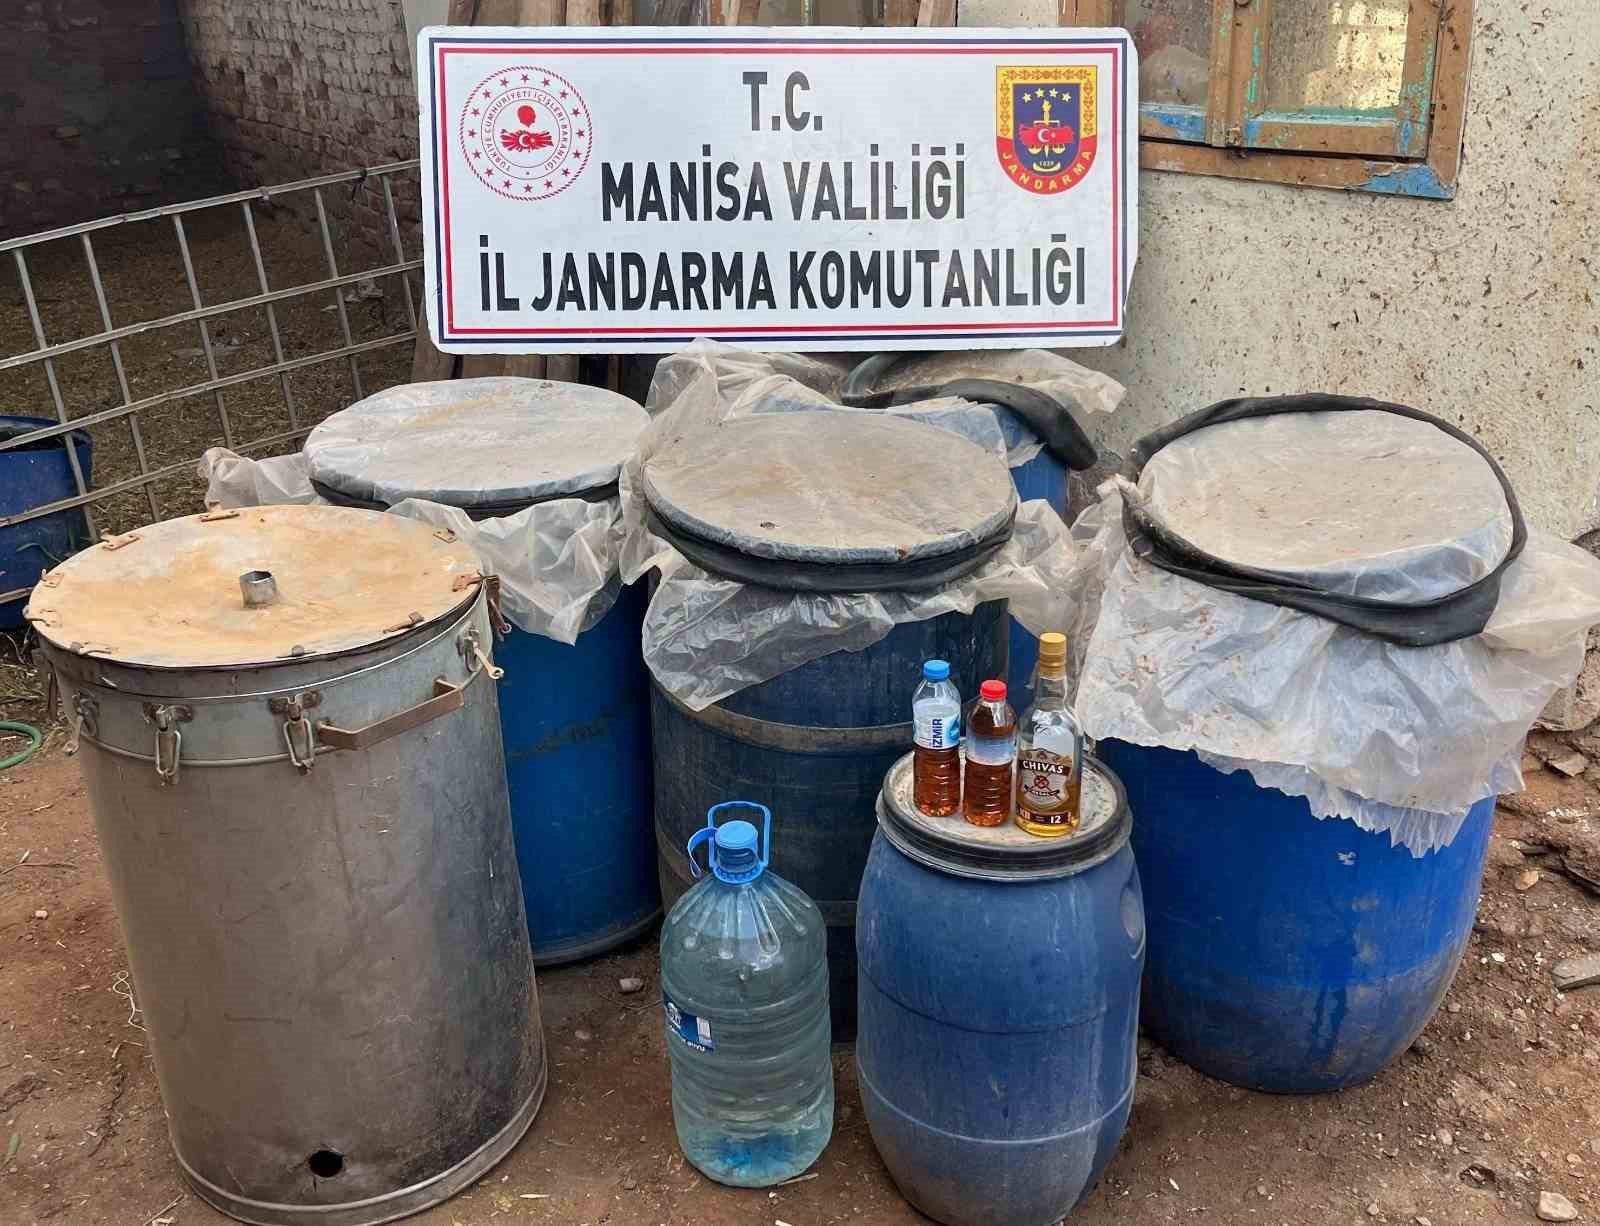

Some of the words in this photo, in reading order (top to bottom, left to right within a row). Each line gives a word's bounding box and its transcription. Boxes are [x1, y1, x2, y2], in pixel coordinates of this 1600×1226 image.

[742, 71, 823, 131] T.C.
[601, 143, 773, 222] MANİSA
[783, 143, 965, 221] VALİLİĞİ
[1002, 150, 1093, 191] JANDARMA
[479, 234, 520, 312] İL
[531, 250, 777, 312] JANDARMA
[789, 233, 1085, 310] KOMUTANLIĞI
[1022, 759, 1065, 775] CHIVAS
[1050, 814, 1062, 825] 12
